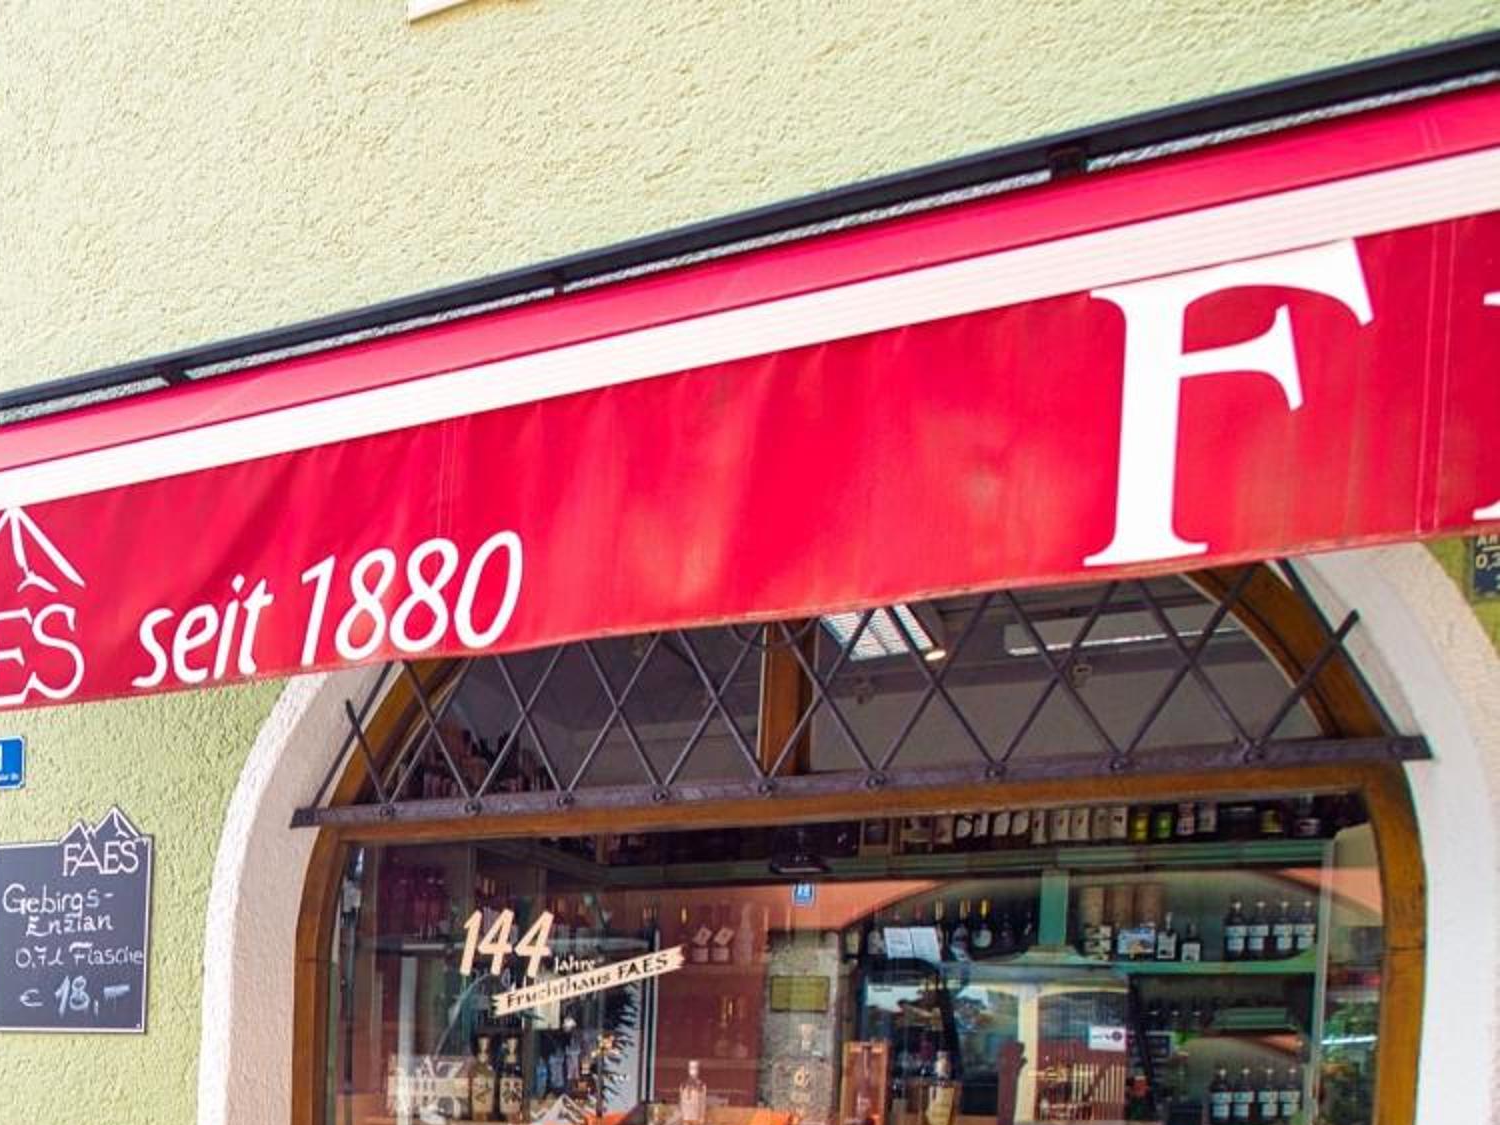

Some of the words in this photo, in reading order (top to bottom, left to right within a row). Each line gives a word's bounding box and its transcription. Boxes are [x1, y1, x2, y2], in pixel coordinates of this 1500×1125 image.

[1083, 238, 1500, 566] F
[131, 573, 275, 688] seit
[300, 530, 524, 668] 1880
[62, 841, 140, 876] FAES
[2, 883, 115, 915] Gebirgs-
[26, 913, 114, 936] Enzian
[460, 908, 554, 976] 144
[555, 957, 596, 974] Jahre
[68, 942, 145, 966] Flasche
[20, 988, 43, 1007] €
[507, 973, 612, 1009] Fruchthaus
[617, 953, 669, 980] FAES
